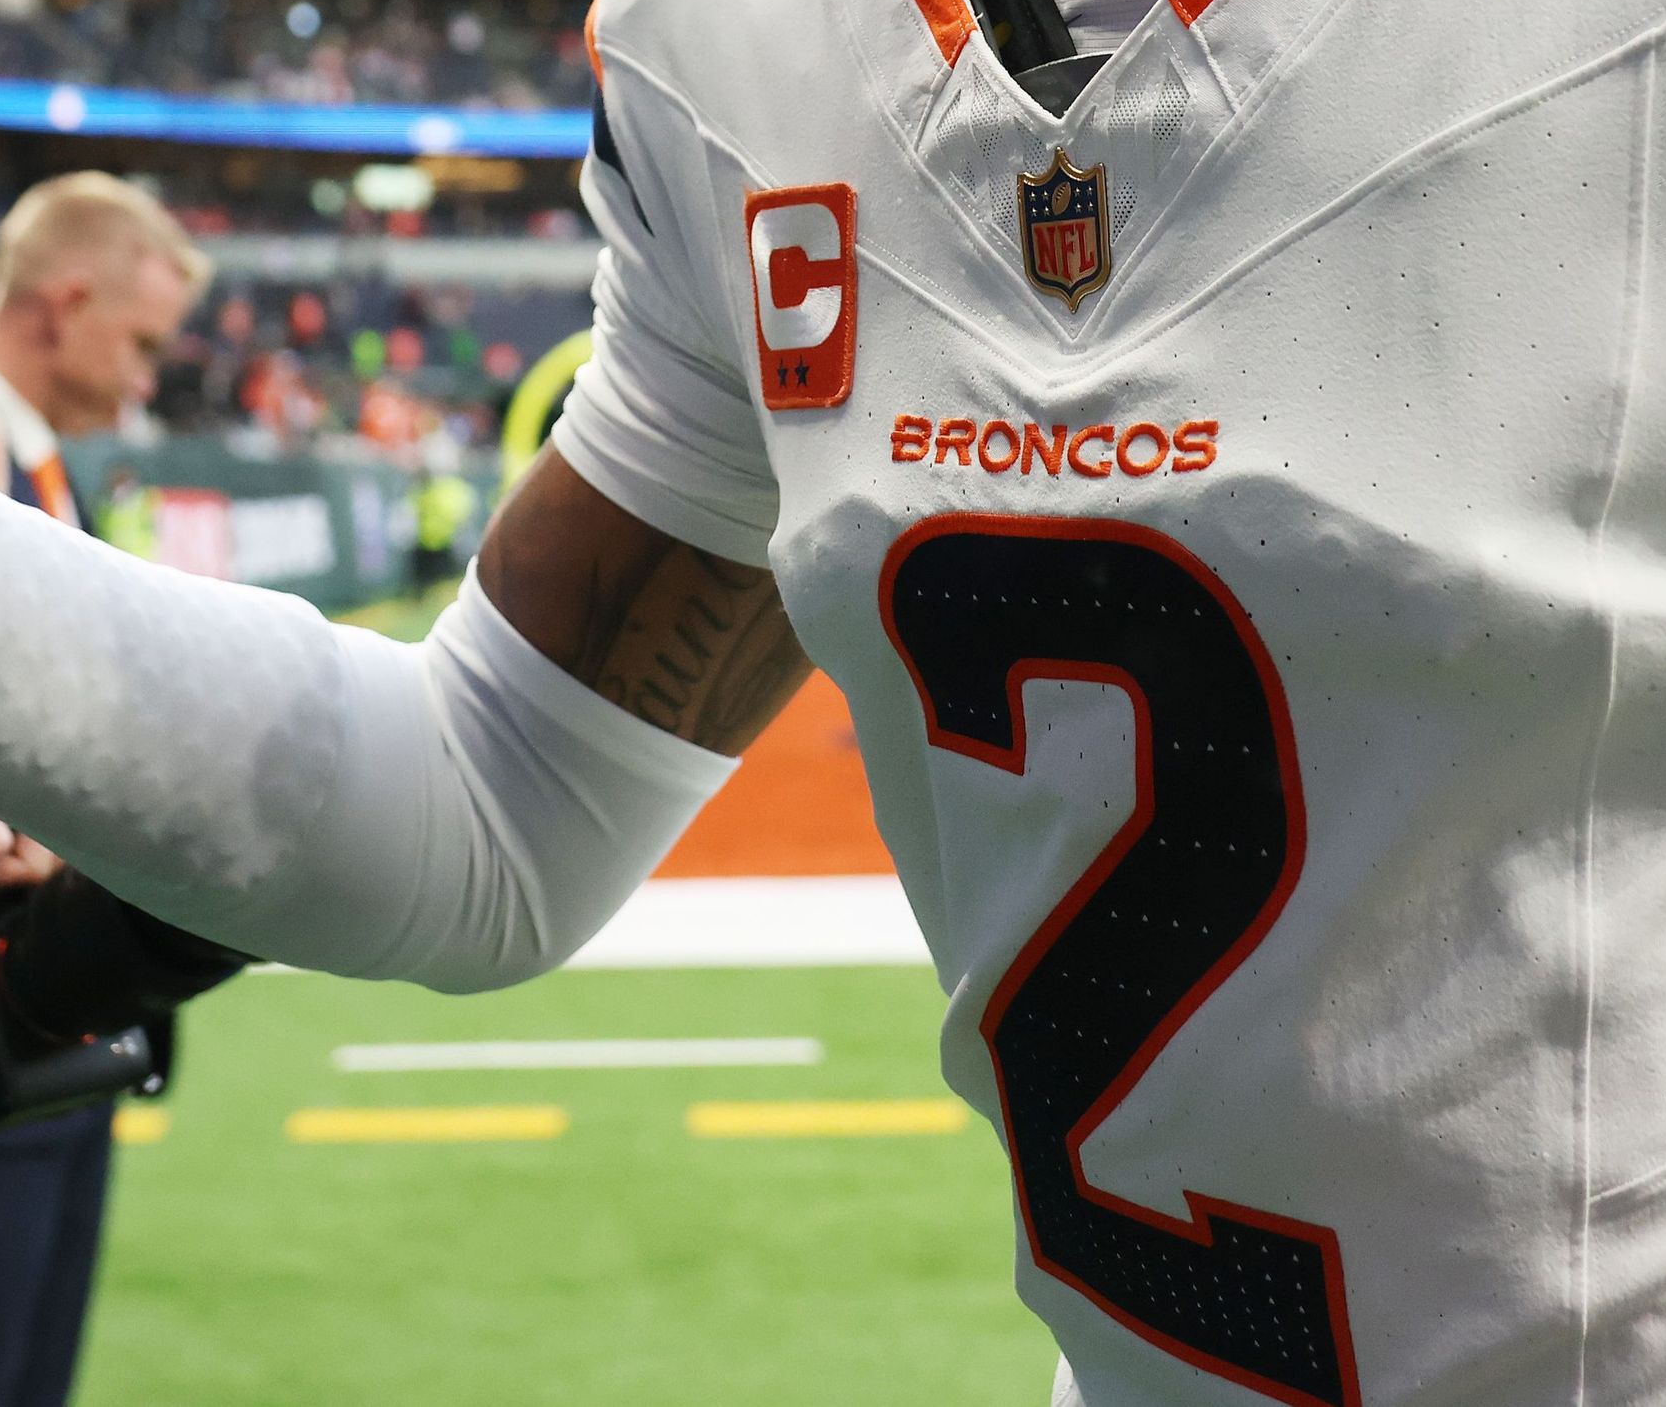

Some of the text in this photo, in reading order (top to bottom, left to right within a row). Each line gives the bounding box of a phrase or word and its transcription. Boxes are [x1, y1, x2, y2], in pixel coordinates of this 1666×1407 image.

[751, 202, 842, 351] C
[1034, 223, 1096, 281] NFL
[890, 413, 1219, 479] BRONCOS
[878, 512, 1362, 1407] 2
